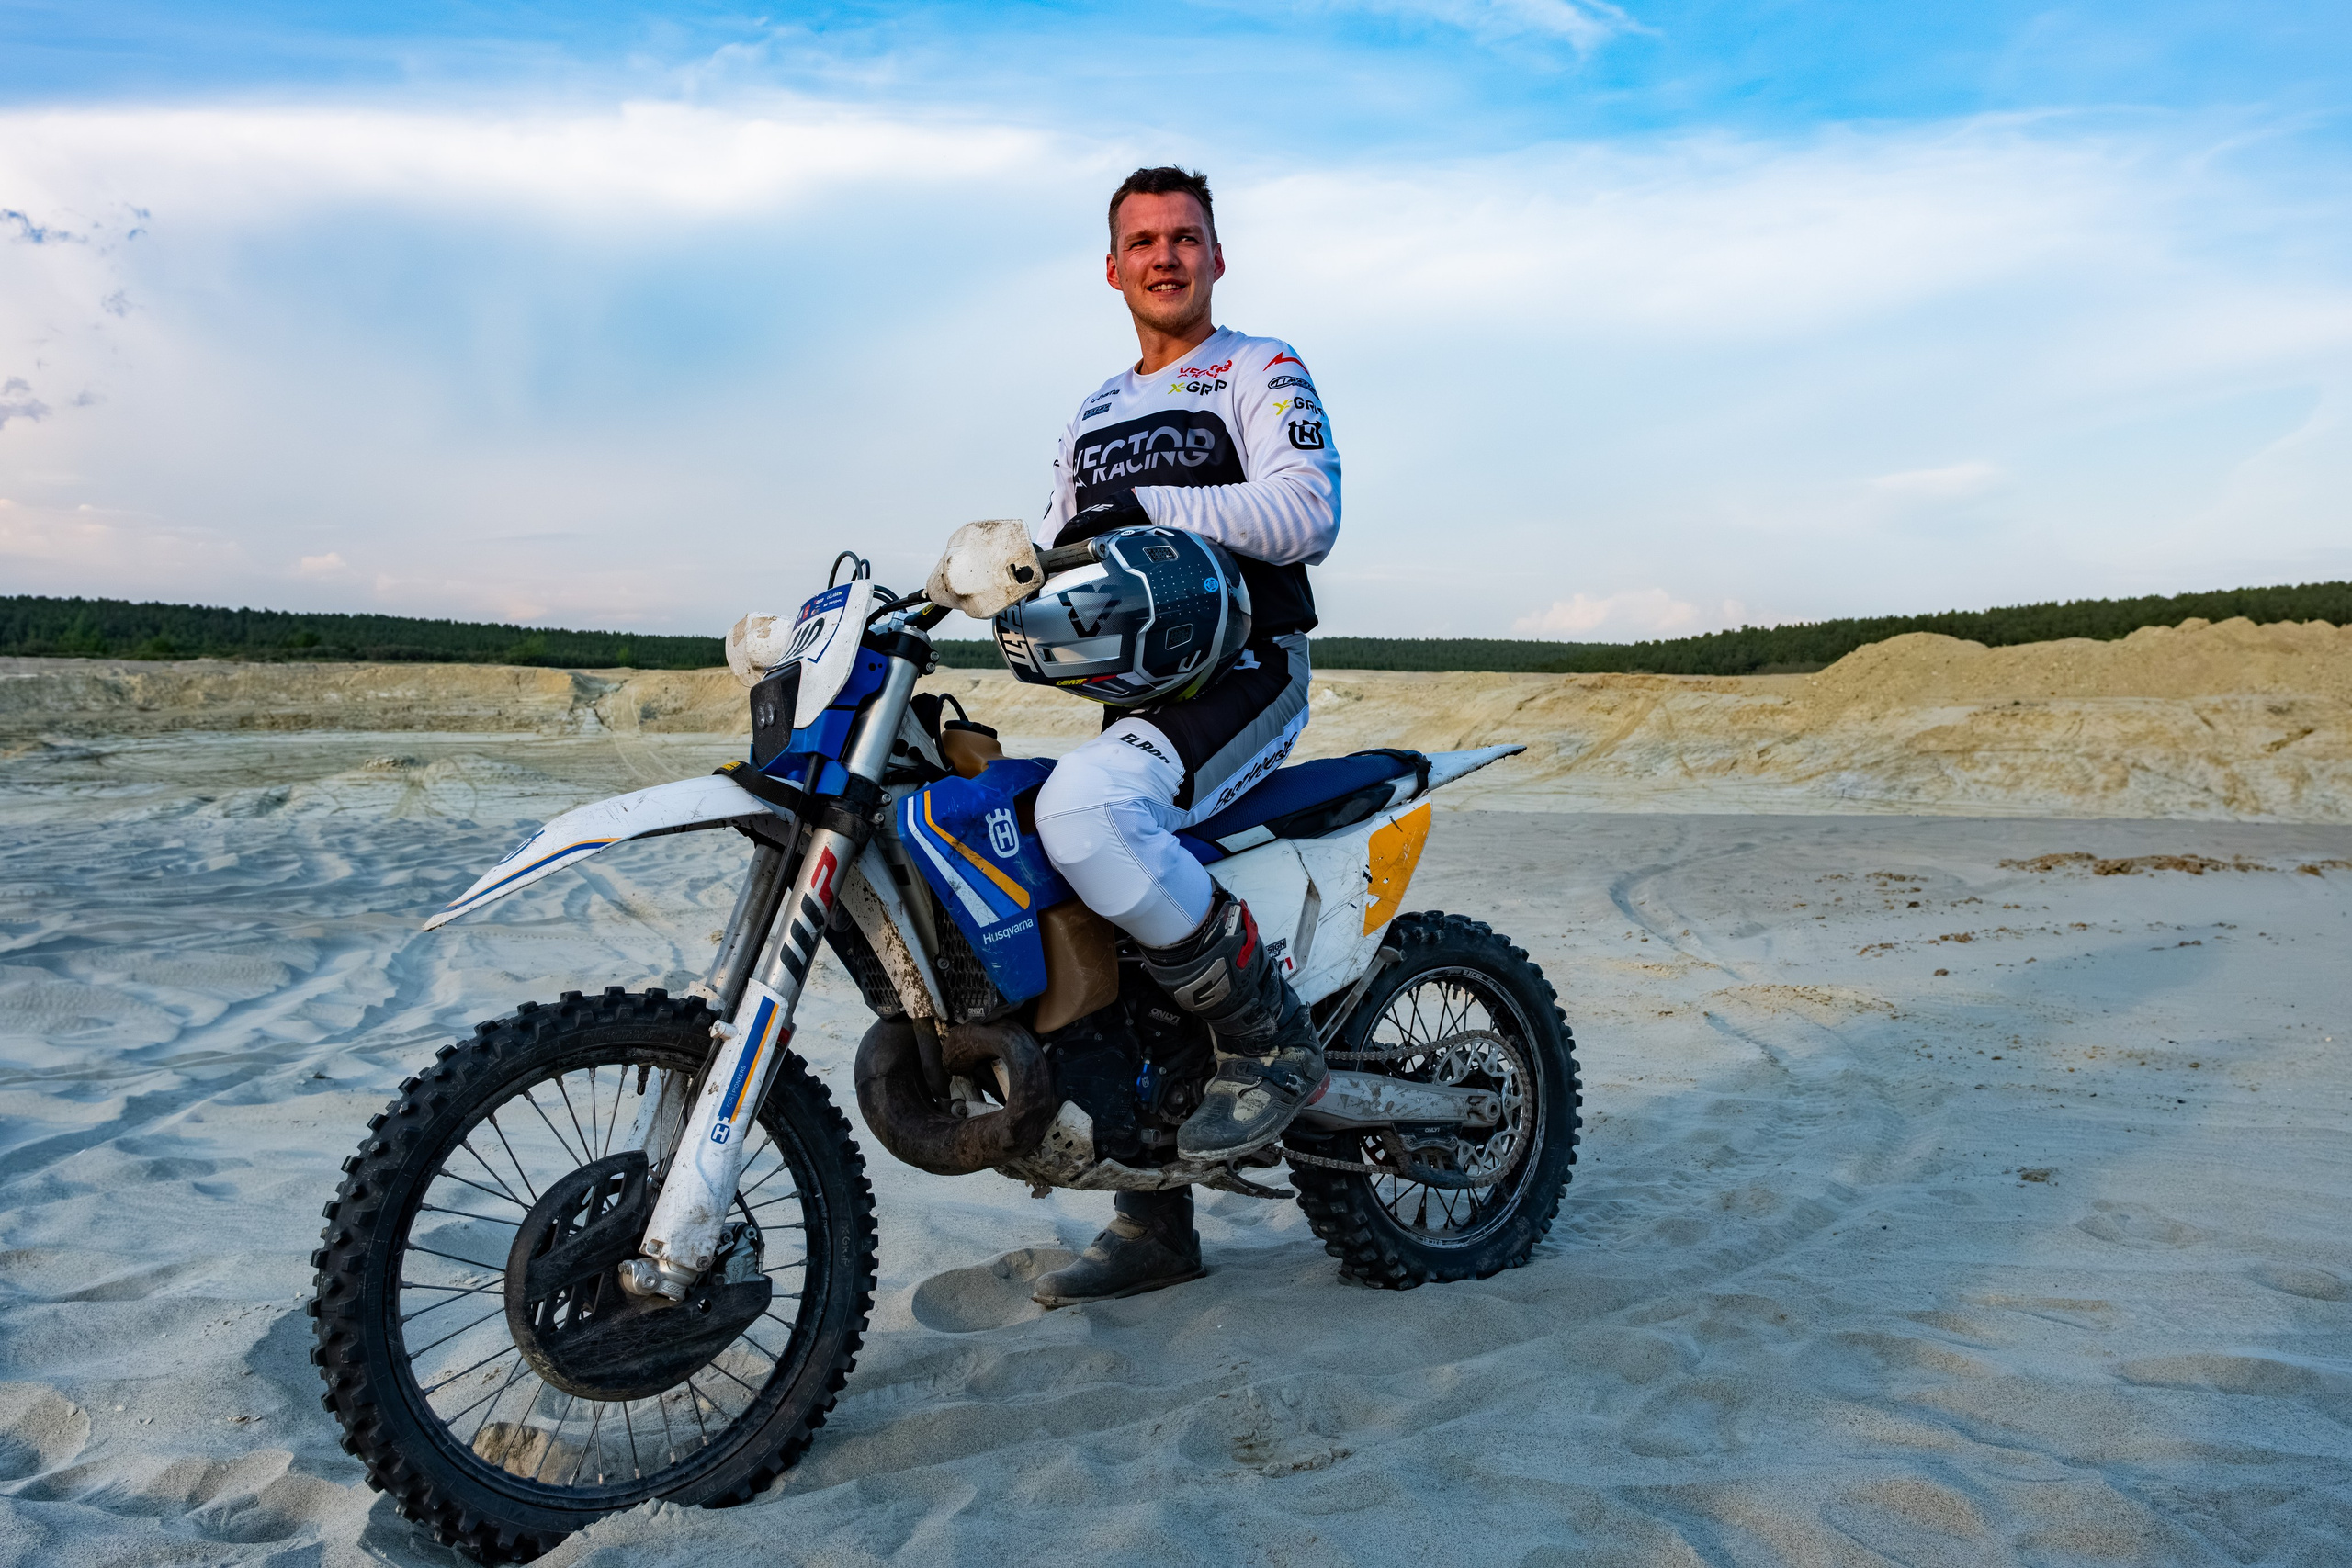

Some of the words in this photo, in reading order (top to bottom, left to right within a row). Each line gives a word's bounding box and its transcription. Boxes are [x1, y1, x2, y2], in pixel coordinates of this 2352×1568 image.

[1091, 450, 1210, 485] RACING
[982, 918, 1035, 945] Husqvarna
[731, 1065, 747, 1094] PIONEERS
